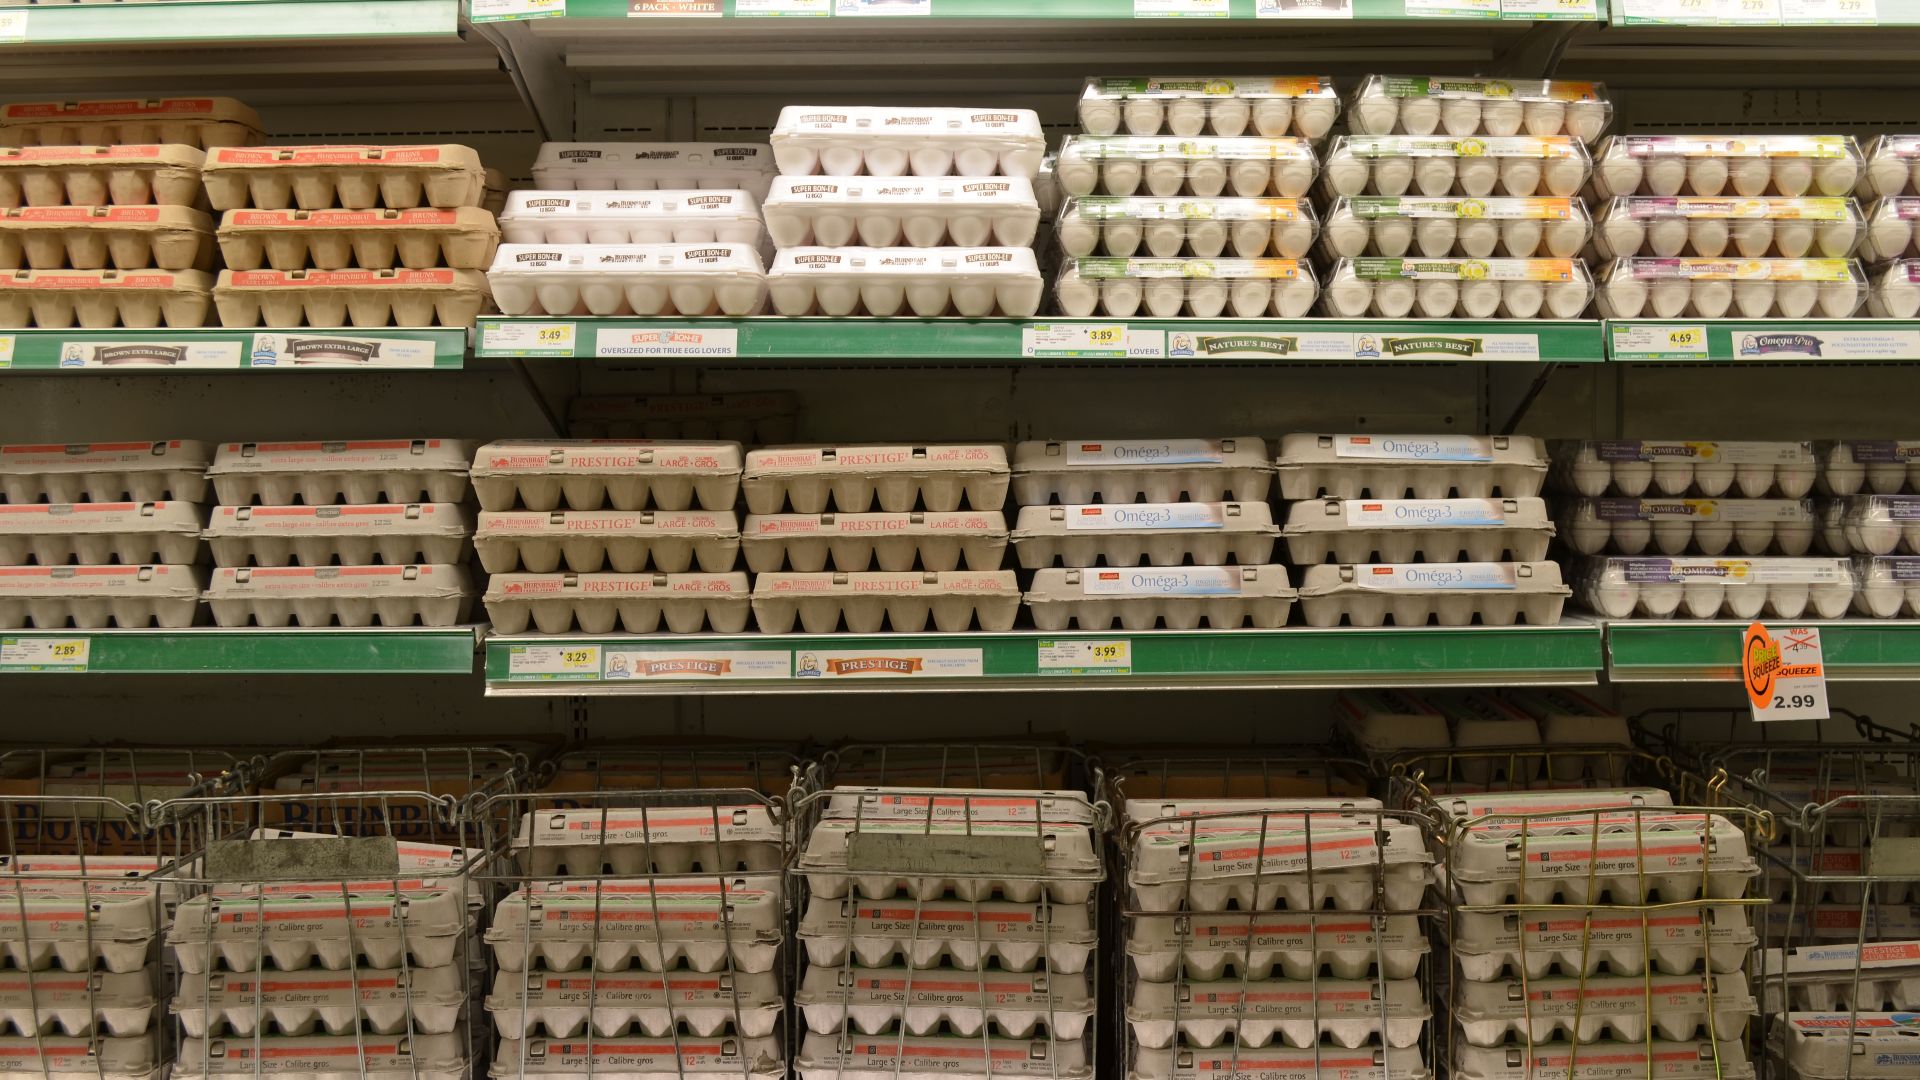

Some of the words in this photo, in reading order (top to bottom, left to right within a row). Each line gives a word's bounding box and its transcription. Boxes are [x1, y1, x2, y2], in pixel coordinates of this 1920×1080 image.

[645, 3, 670, 11] PACK
[677, 3, 715, 11] WHITE
[1742, 1, 1764, 10] 2.79
[1839, 1, 1861, 10] 2.79
[963, 184, 984, 192] SUPER
[526, 199, 546, 208] SUPER
[688, 197, 707, 205] SUPER
[516, 253, 537, 262] SUPER
[685, 250, 705, 258] SUPER
[795, 256, 816, 264] SUPER
[540, 330, 561, 340] 3.49
[633, 335, 658, 343] SUPER
[1091, 331, 1113, 340] 3.89
[1670, 333, 1692, 343] 4.69
[1209, 341, 1258, 350] NATURE'S
[1259, 341, 1284, 350] BEST
[1394, 341, 1443, 352] NATURE'S
[1445, 343, 1470, 352] BEST
[1759, 336, 1791, 348] Omega
[347, 345, 370, 353] LARGE
[154, 350, 176, 358] LARGE
[1383, 439, 1439, 457] Oméga-3
[1653, 447, 1684, 455] OMEGA
[931, 452, 960, 461] LARGE
[966, 451, 989, 459] GROS
[1114, 445, 1170, 462] Oméga-3
[571, 456, 636, 467] PRESTIGE
[660, 459, 689, 468] LARGE
[1395, 505, 1452, 521] Oméga-3
[1652, 505, 1684, 513] OMEGA
[1114, 509, 1171, 526] Oméga-3
[658, 520, 686, 528] LARGE
[692, 520, 716, 528] GROS
[931, 520, 960, 528] LARGE
[1683, 567, 1715, 576] OMEGA
[1406, 569, 1462, 585] Oméga-3
[944, 582, 973, 590] LARGE
[979, 582, 1002, 590] GROS
[1132, 574, 1189, 591] Oméga-3
[673, 583, 702, 591] LARGE
[707, 584, 731, 592] GROS
[55, 646, 75, 655] 2.89
[1095, 647, 1115, 656] 3.99
[566, 653, 587, 662] 3.29
[651, 662, 717, 672] PRESTIGE
[842, 662, 908, 671] PRESTIGE
[1753, 657, 1780, 680] SQUEEZE
[1774, 695, 1814, 709] 2.99
[1008, 808, 1017, 816] 12
[1340, 850, 1350, 859] 12
[1213, 862, 1235, 873] Large
[1236, 862, 1253, 870] Size
[1261, 858, 1289, 867] Calibre
[1667, 856, 1677, 866] 12
[356, 919, 366, 928] 12
[871, 921, 893, 931] Large
[895, 921, 910, 930] Size
[919, 922, 946, 931] Calibre
[947, 924, 964, 932] gros
[997, 923, 1006, 932] 12
[1665, 927, 1675, 937] 12
[1209, 937, 1232, 948] Large
[1233, 937, 1249, 945] Size
[1257, 936, 1285, 946] Calibre
[1286, 937, 1303, 946] gros
[1336, 935, 1346, 944] 12
[1539, 933, 1560, 943] Large
[1562, 933, 1578, 941] Size
[1616, 932, 1633, 941] gros
[1863, 946, 1905, 954] PRESTIGE
[361, 991, 371, 999] 12
[684, 991, 694, 1000] 12
[870, 992, 892, 1002] Large
[918, 993, 945, 1001] Calibre
[946, 994, 963, 1002] gros
[995, 993, 1006, 1003] 12
[1668, 996, 1678, 1005] 12
[1207, 1005, 1230, 1015] Large
[1255, 1004, 1283, 1013] Calibre
[1285, 1005, 1302, 1014] gros
[1335, 1003, 1344, 1012] 12
[1543, 1003, 1564, 1012] Large
[1590, 1000, 1618, 1009] Calibre
[1619, 1000, 1636, 1009] gros
[685, 1056, 695, 1065] 12
[1664, 1064, 1674, 1073] 12
[1338, 1069, 1349, 1079] 12
